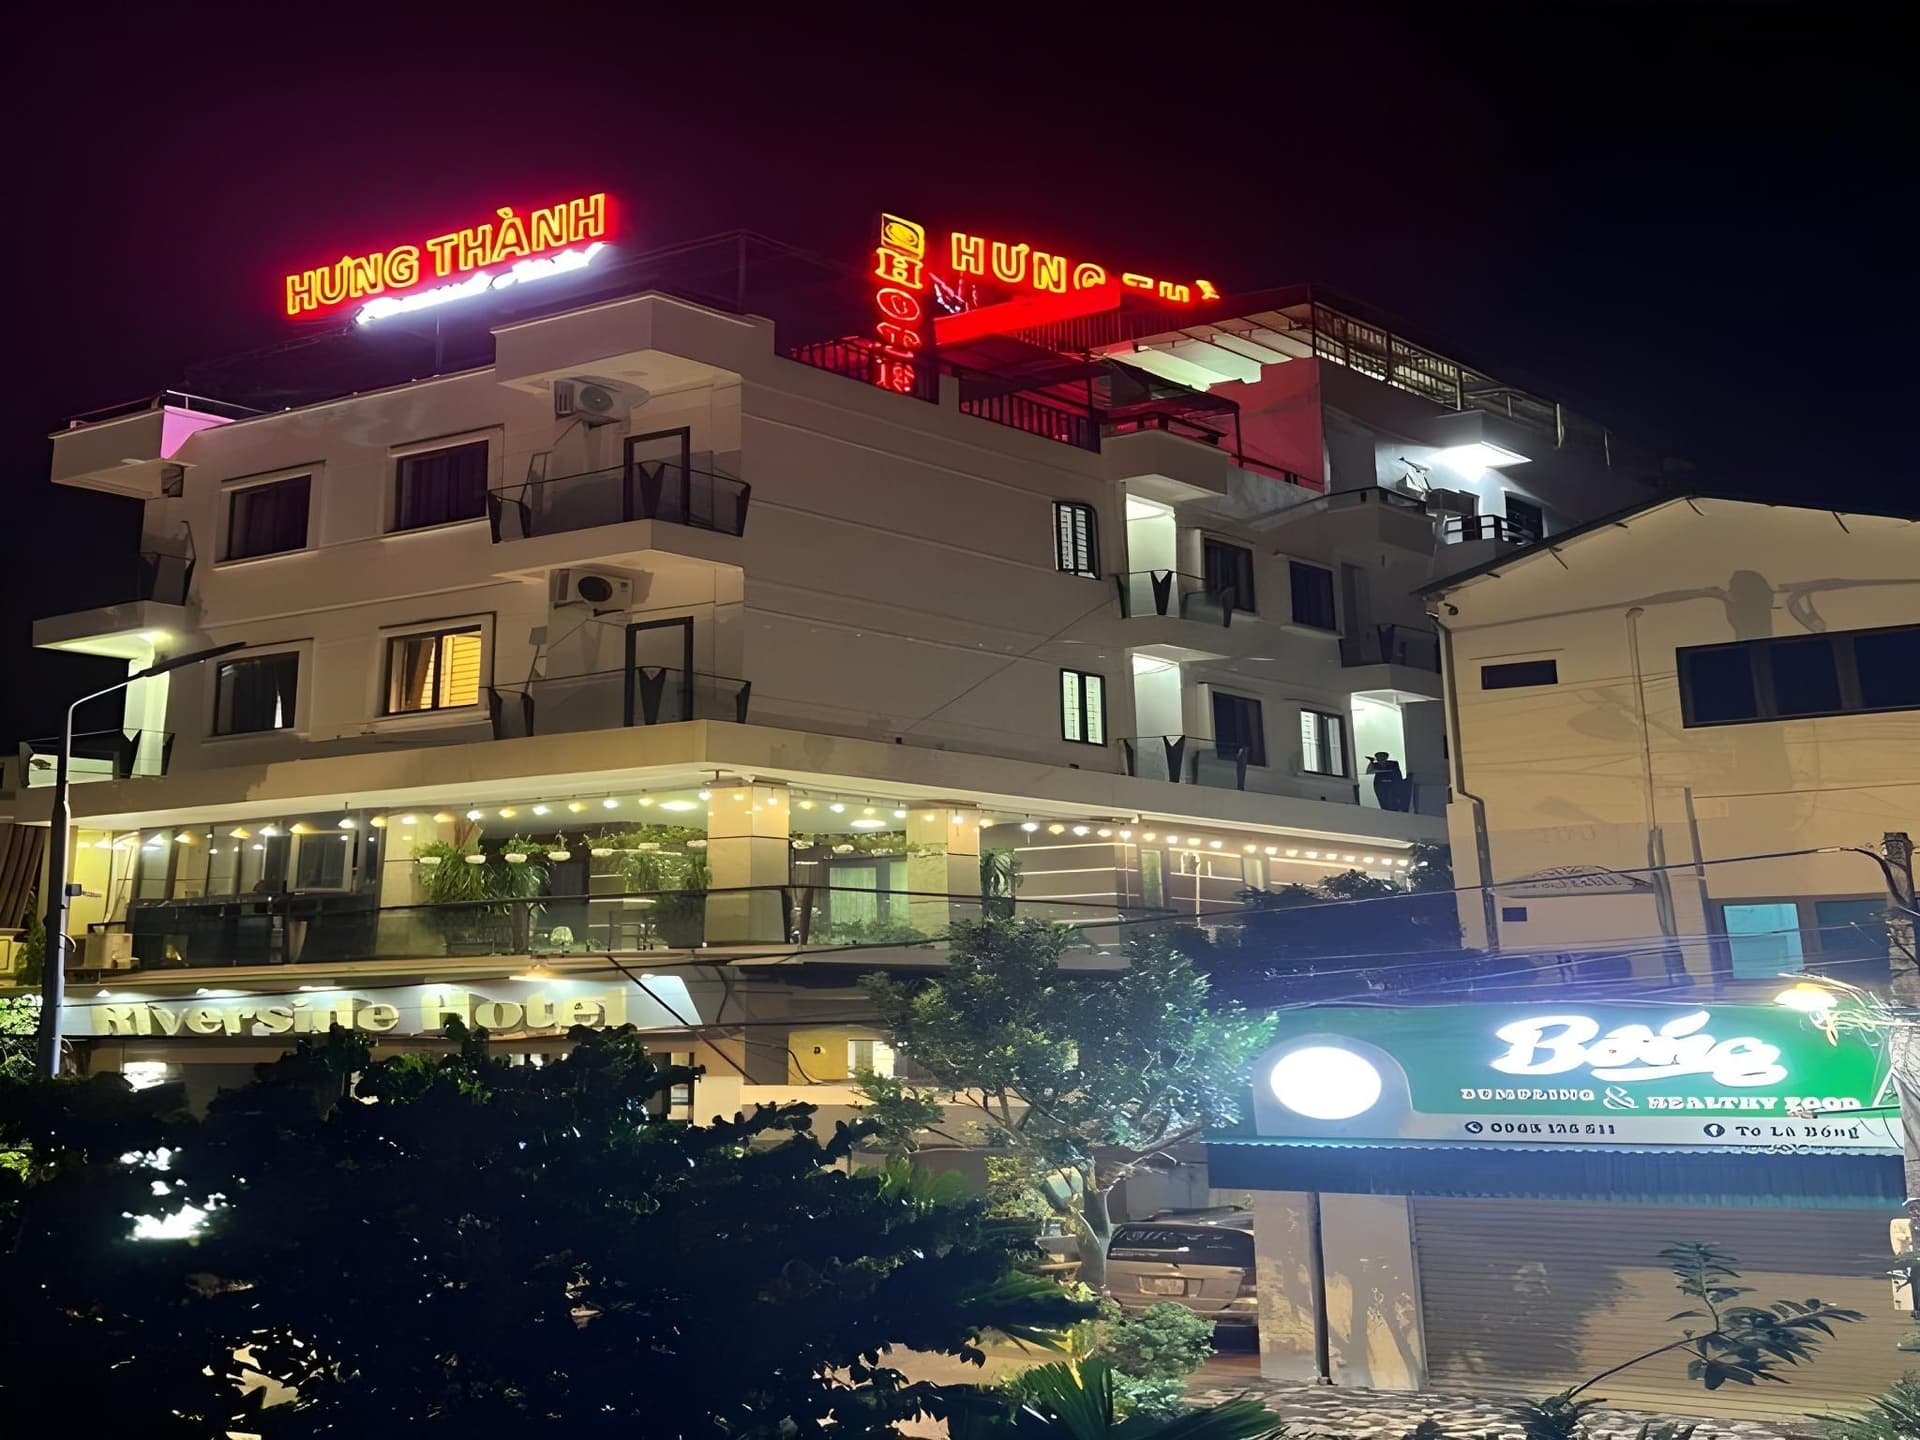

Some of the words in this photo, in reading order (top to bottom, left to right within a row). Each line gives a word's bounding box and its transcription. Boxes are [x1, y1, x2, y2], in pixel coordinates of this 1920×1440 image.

[286, 245, 419, 315] HƯNG
[426, 192, 605, 277] THÀNH
[94, 998, 399, 1036] Riverside
[421, 987, 627, 1030] Hotel
[1648, 1096, 1778, 1110] HEALTHY
